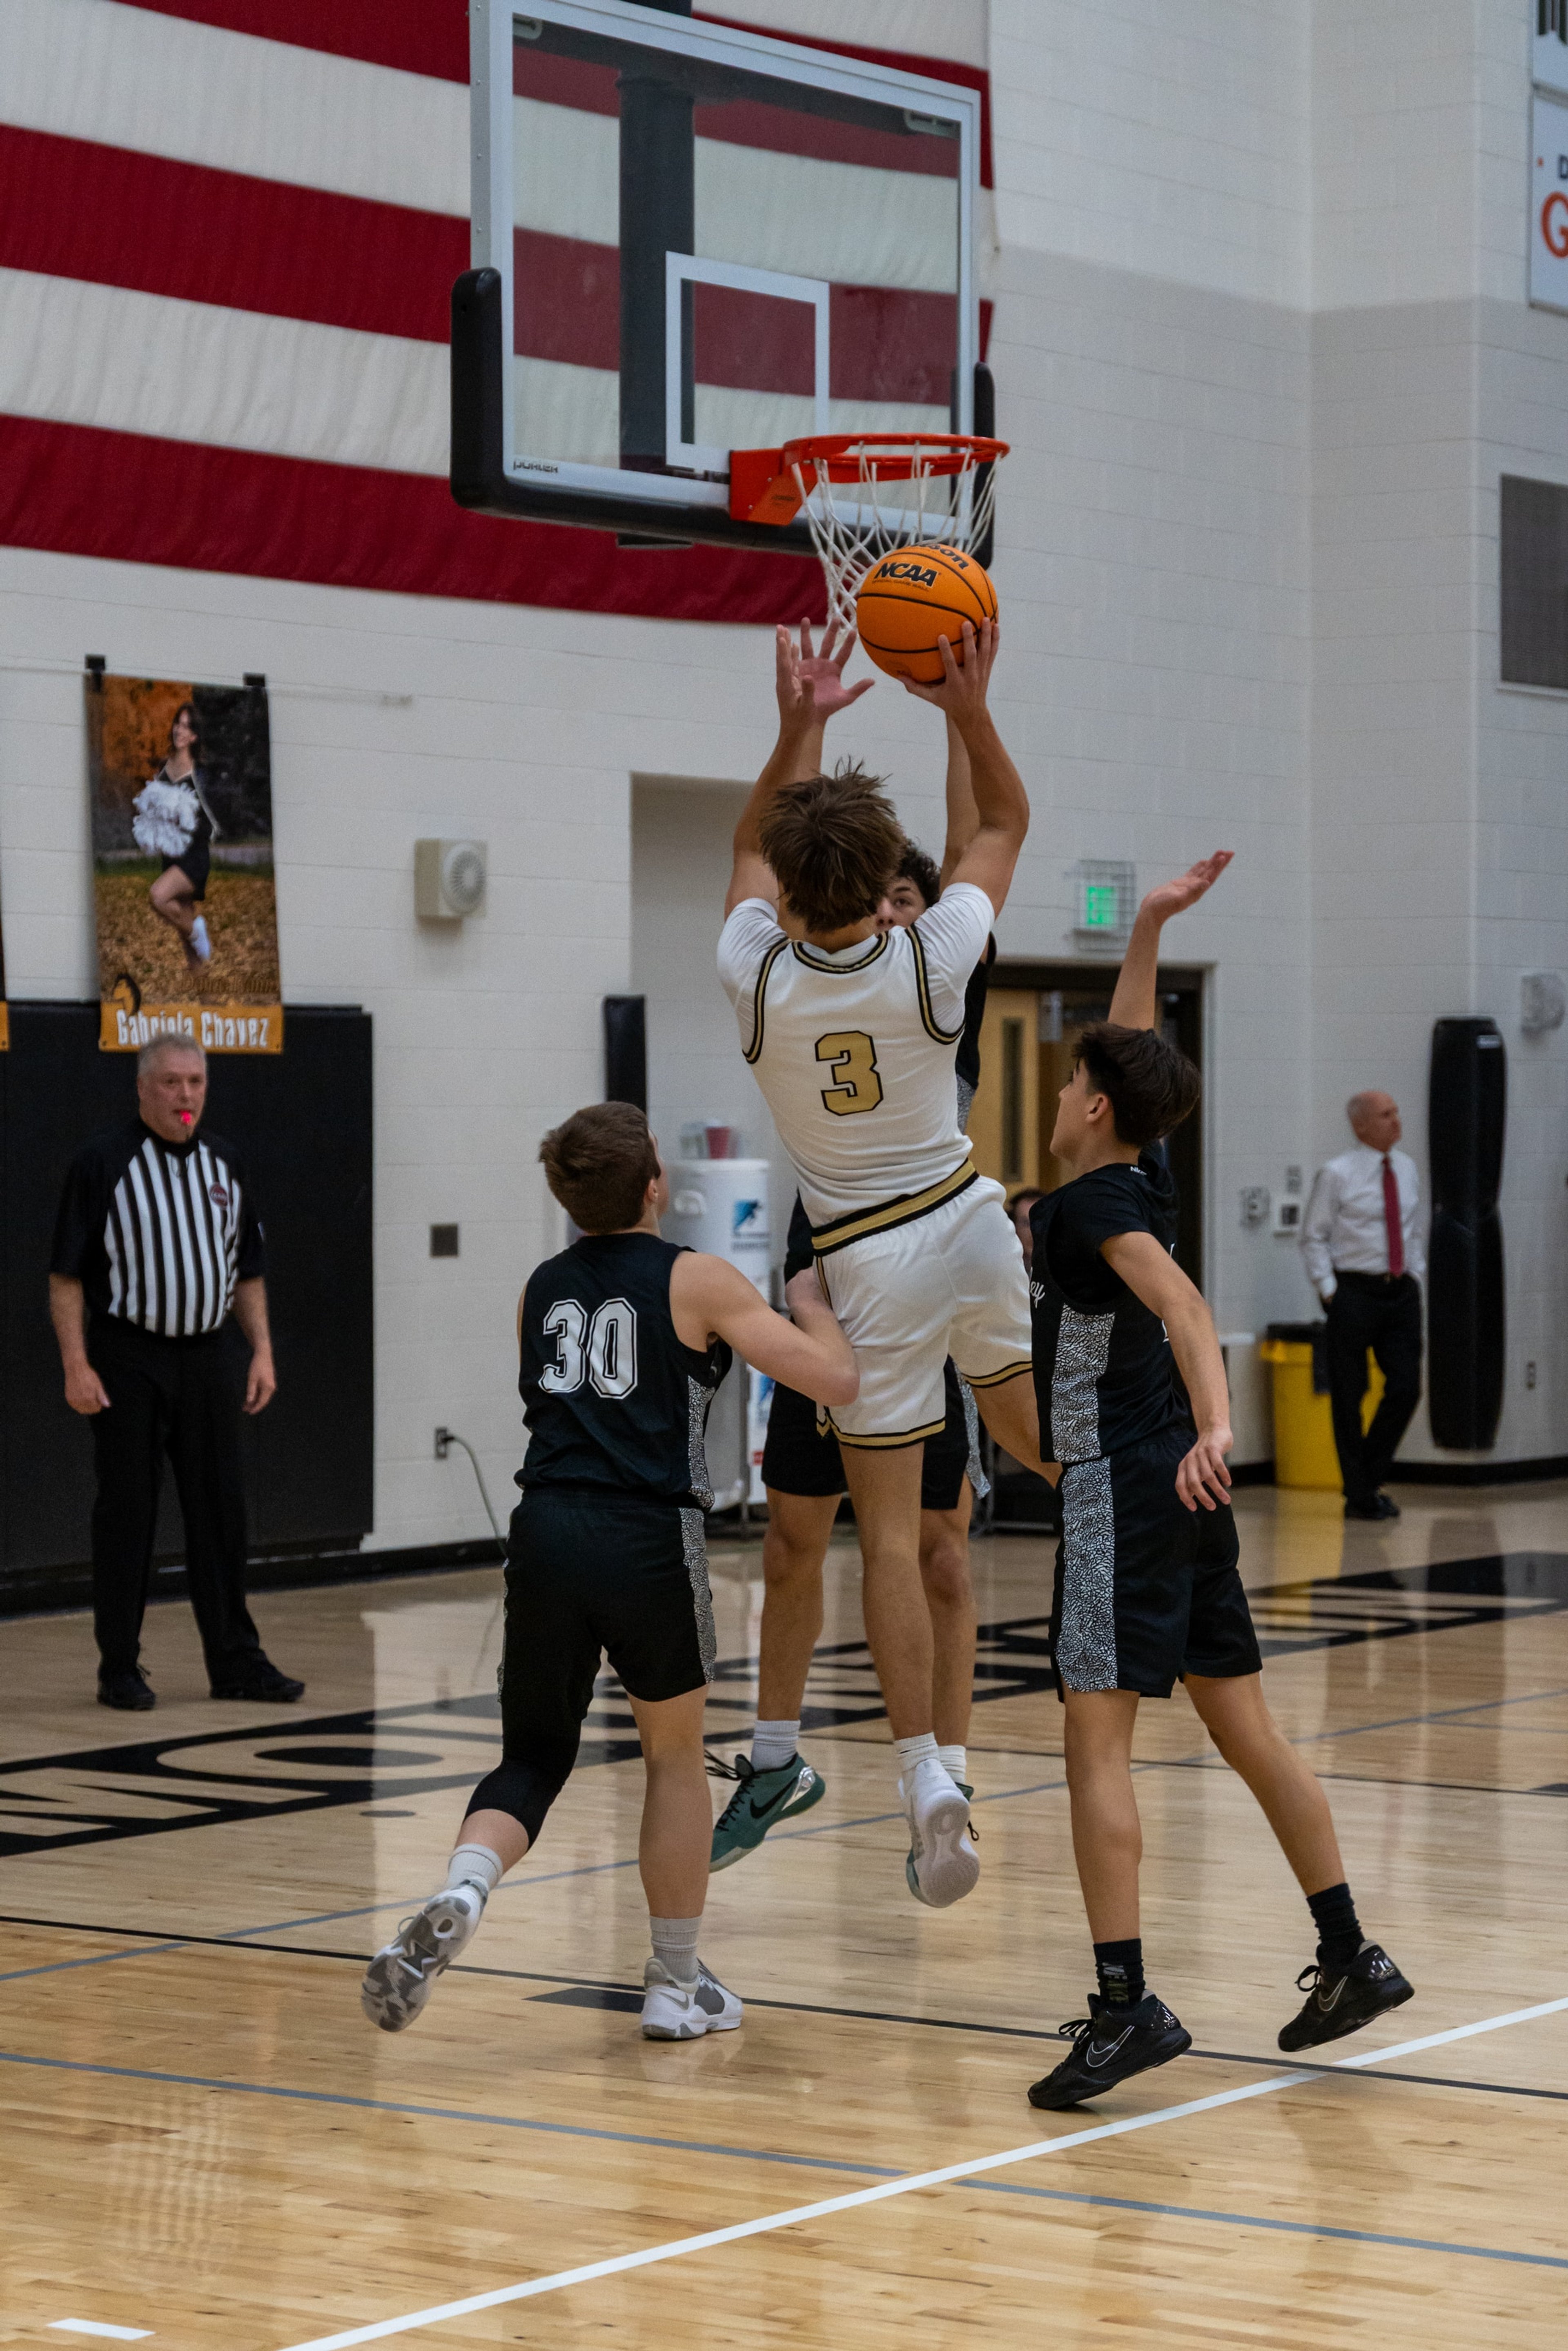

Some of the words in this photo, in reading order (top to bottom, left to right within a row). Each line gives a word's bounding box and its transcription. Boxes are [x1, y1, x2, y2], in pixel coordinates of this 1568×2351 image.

[874, 562, 938, 588] NCAA
[201, 1011, 268, 1048] Chavez
[815, 1030, 883, 1116] 3
[538, 1297, 638, 1400] 30
